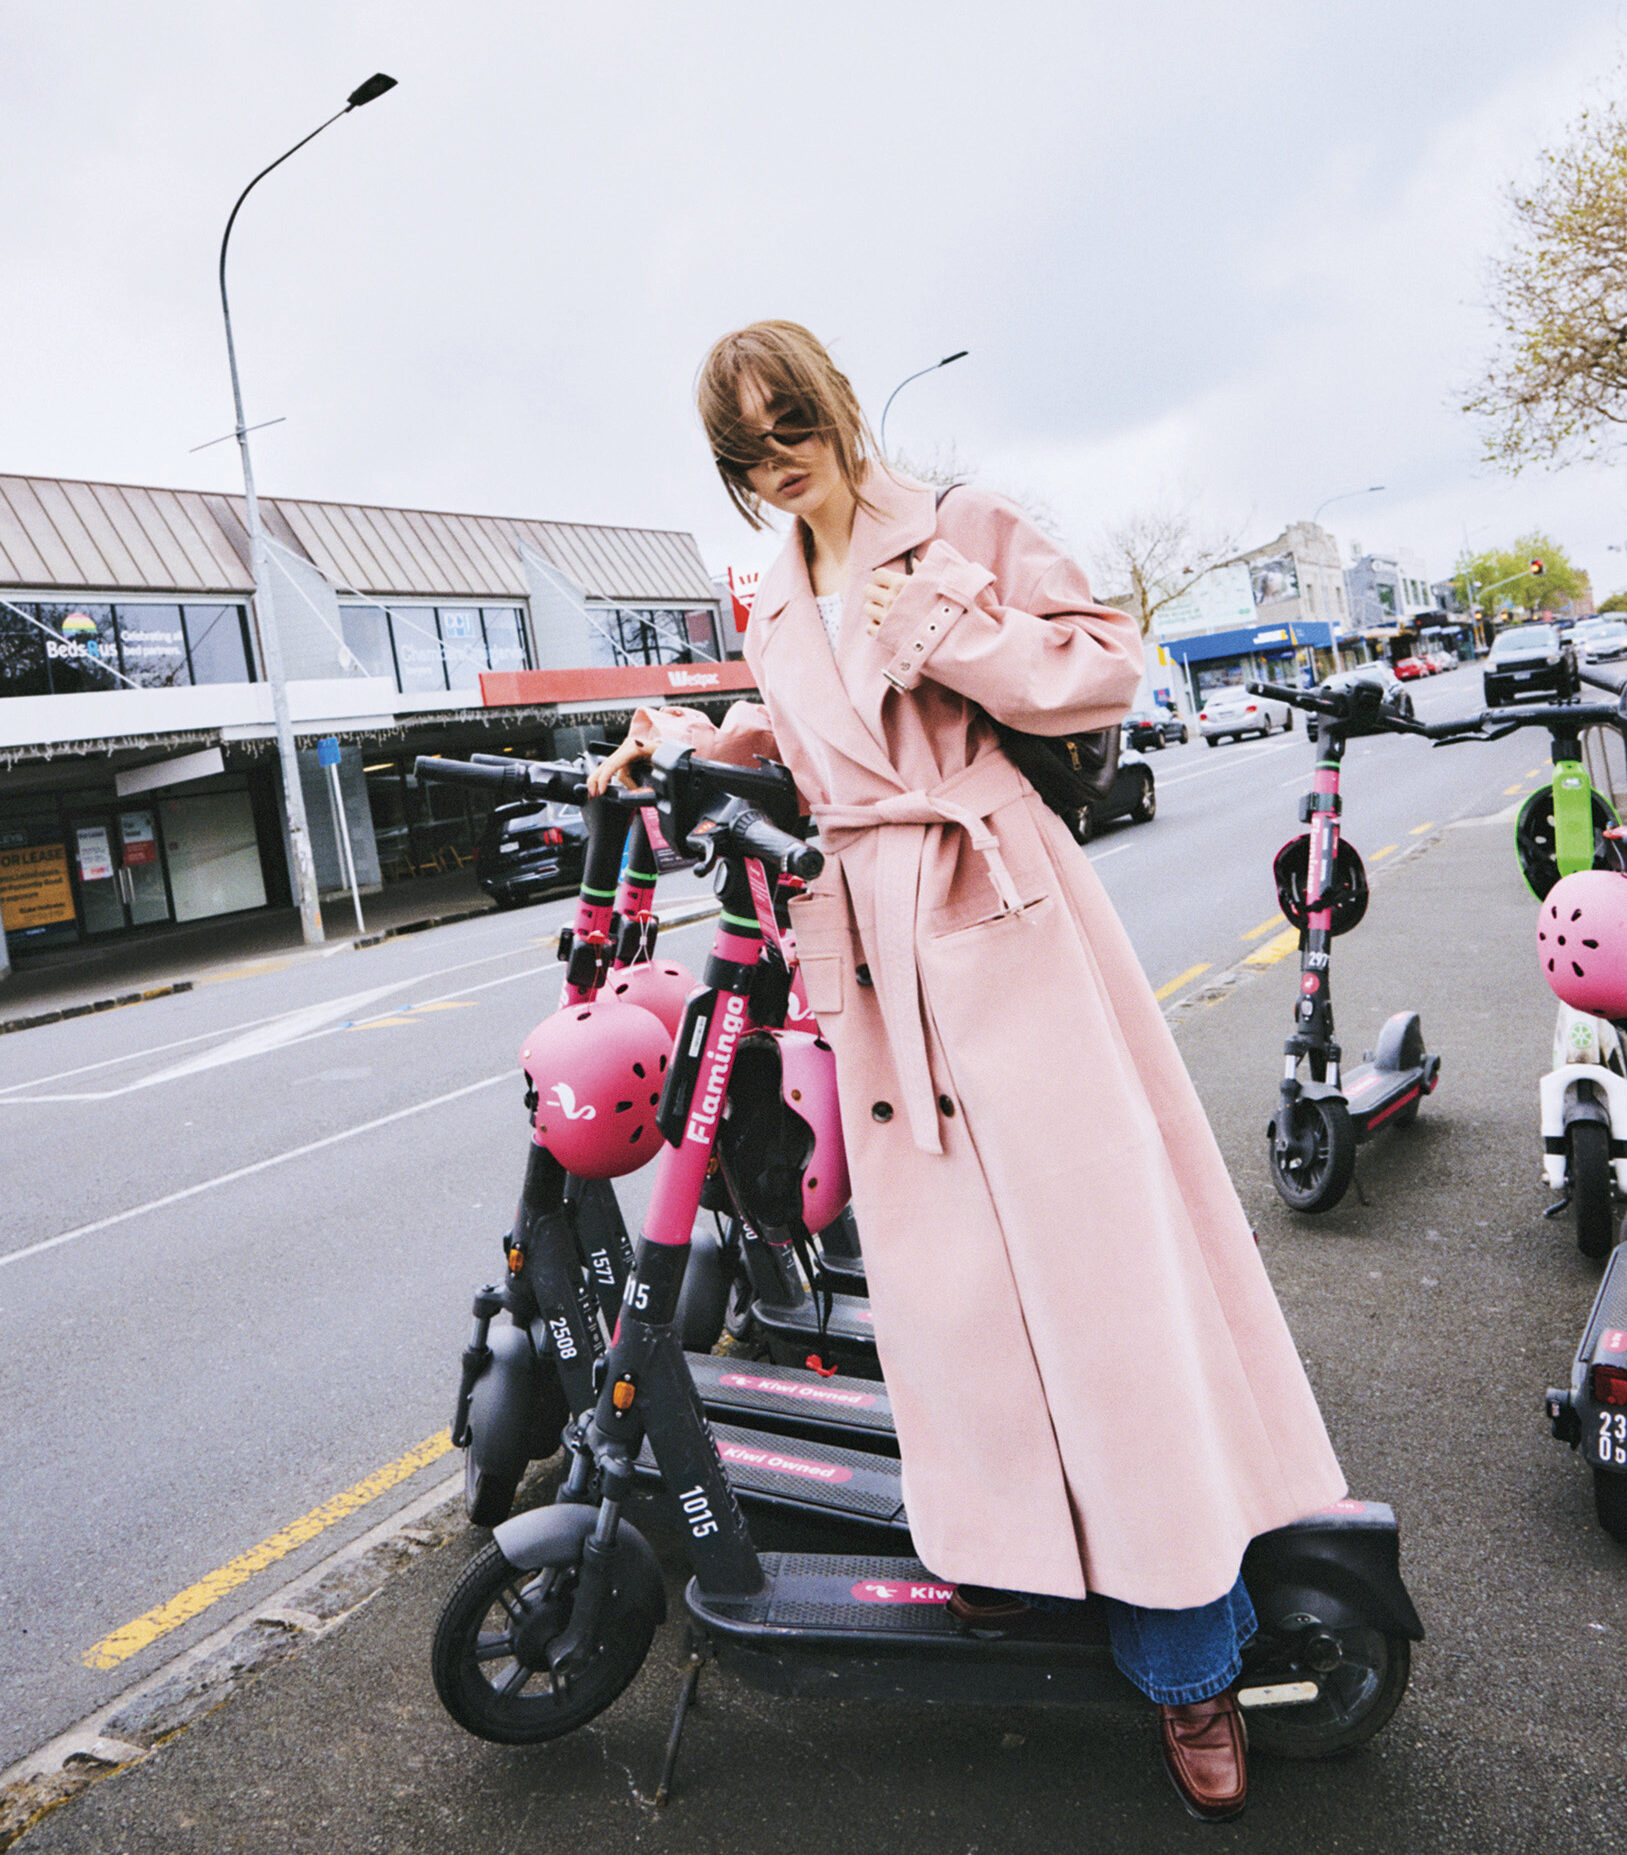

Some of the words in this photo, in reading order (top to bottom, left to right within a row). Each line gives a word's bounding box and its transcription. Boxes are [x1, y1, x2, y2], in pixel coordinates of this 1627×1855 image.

[686, 995, 745, 1145] Flamingo
[591, 1248, 616, 1285] 1577
[549, 1316, 578, 1360] 2508
[758, 1380, 796, 1394] Kiwi
[799, 1387, 862, 1404] Owned
[723, 1447, 767, 1464] Kiwi
[768, 1457, 836, 1478] Owned
[679, 1485, 719, 1539] 1015
[910, 1586, 954, 1601] Kiw
